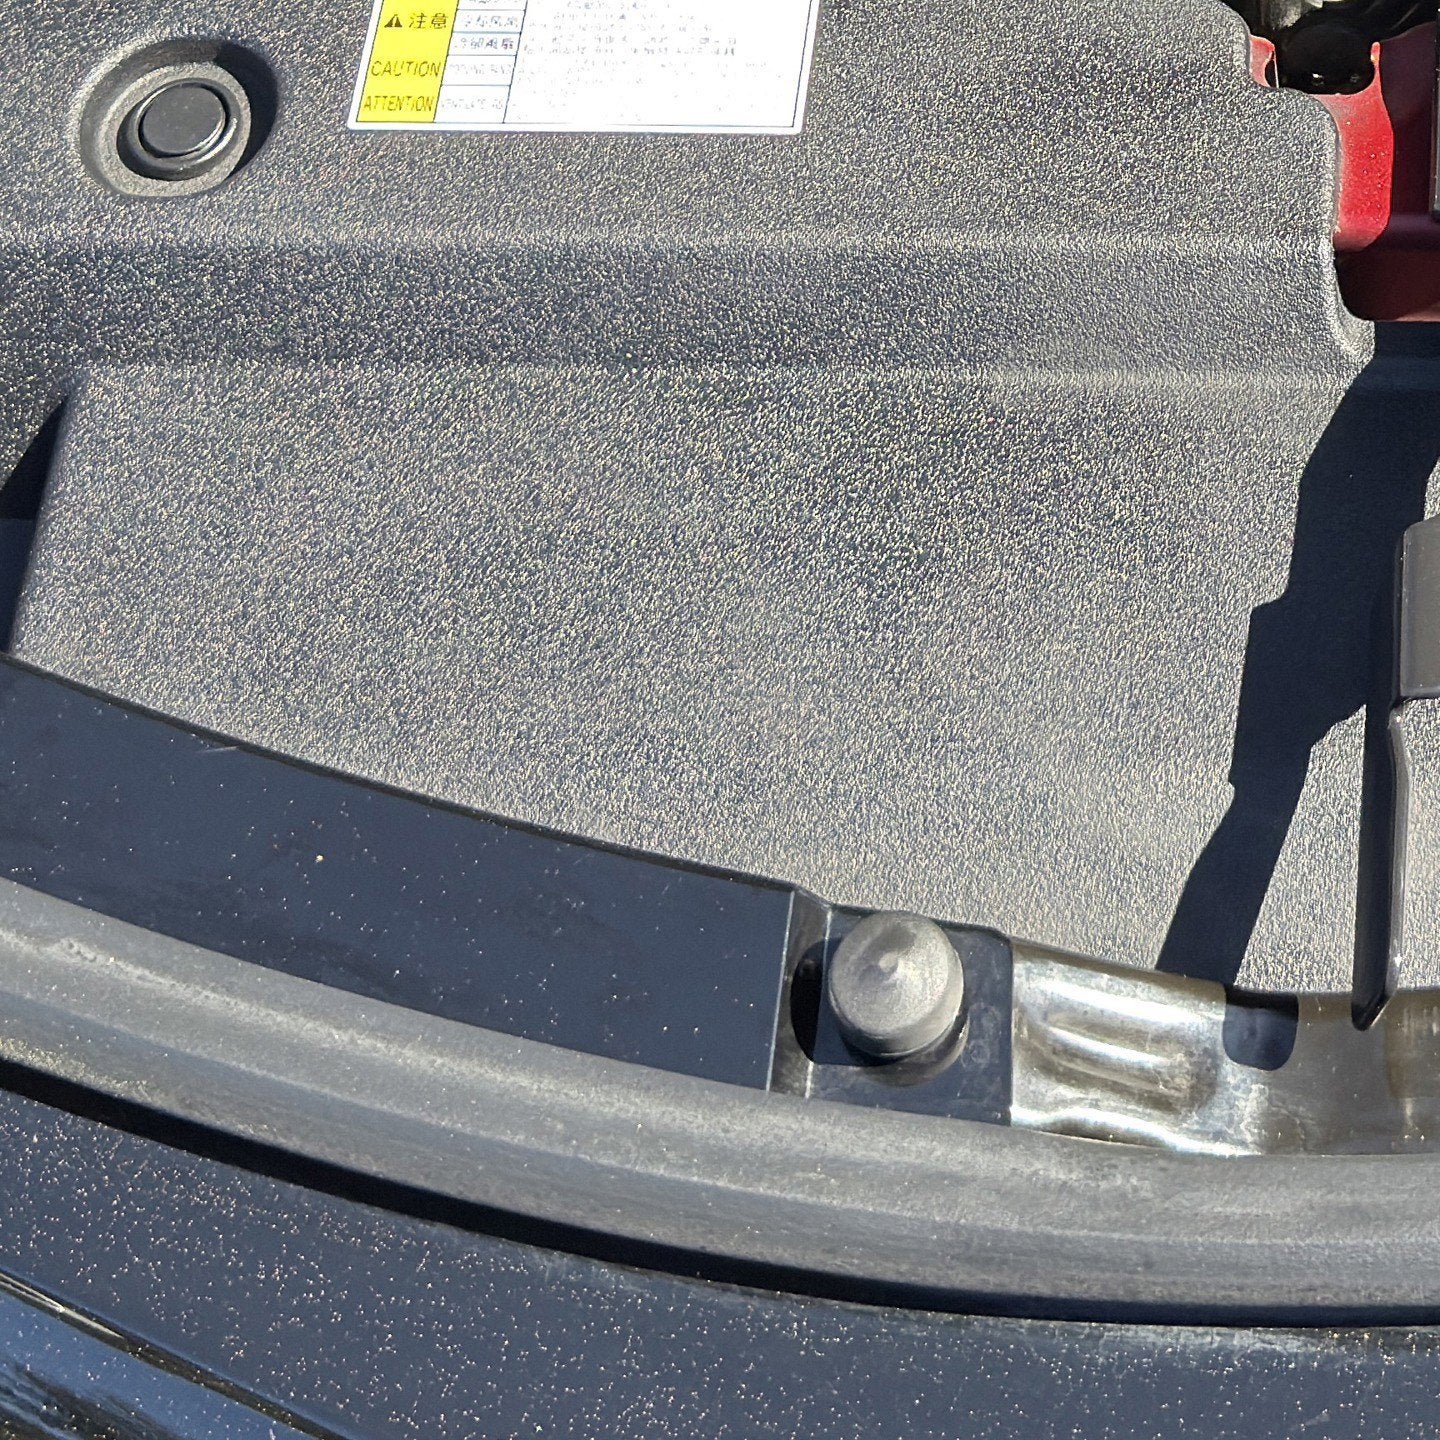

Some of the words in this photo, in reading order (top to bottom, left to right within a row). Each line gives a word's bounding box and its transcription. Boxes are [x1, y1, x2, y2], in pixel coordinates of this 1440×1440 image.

[408, 12, 448, 30] 注意
[370, 59, 442, 78] CAUTION
[362, 95, 435, 112] ATTENTION
